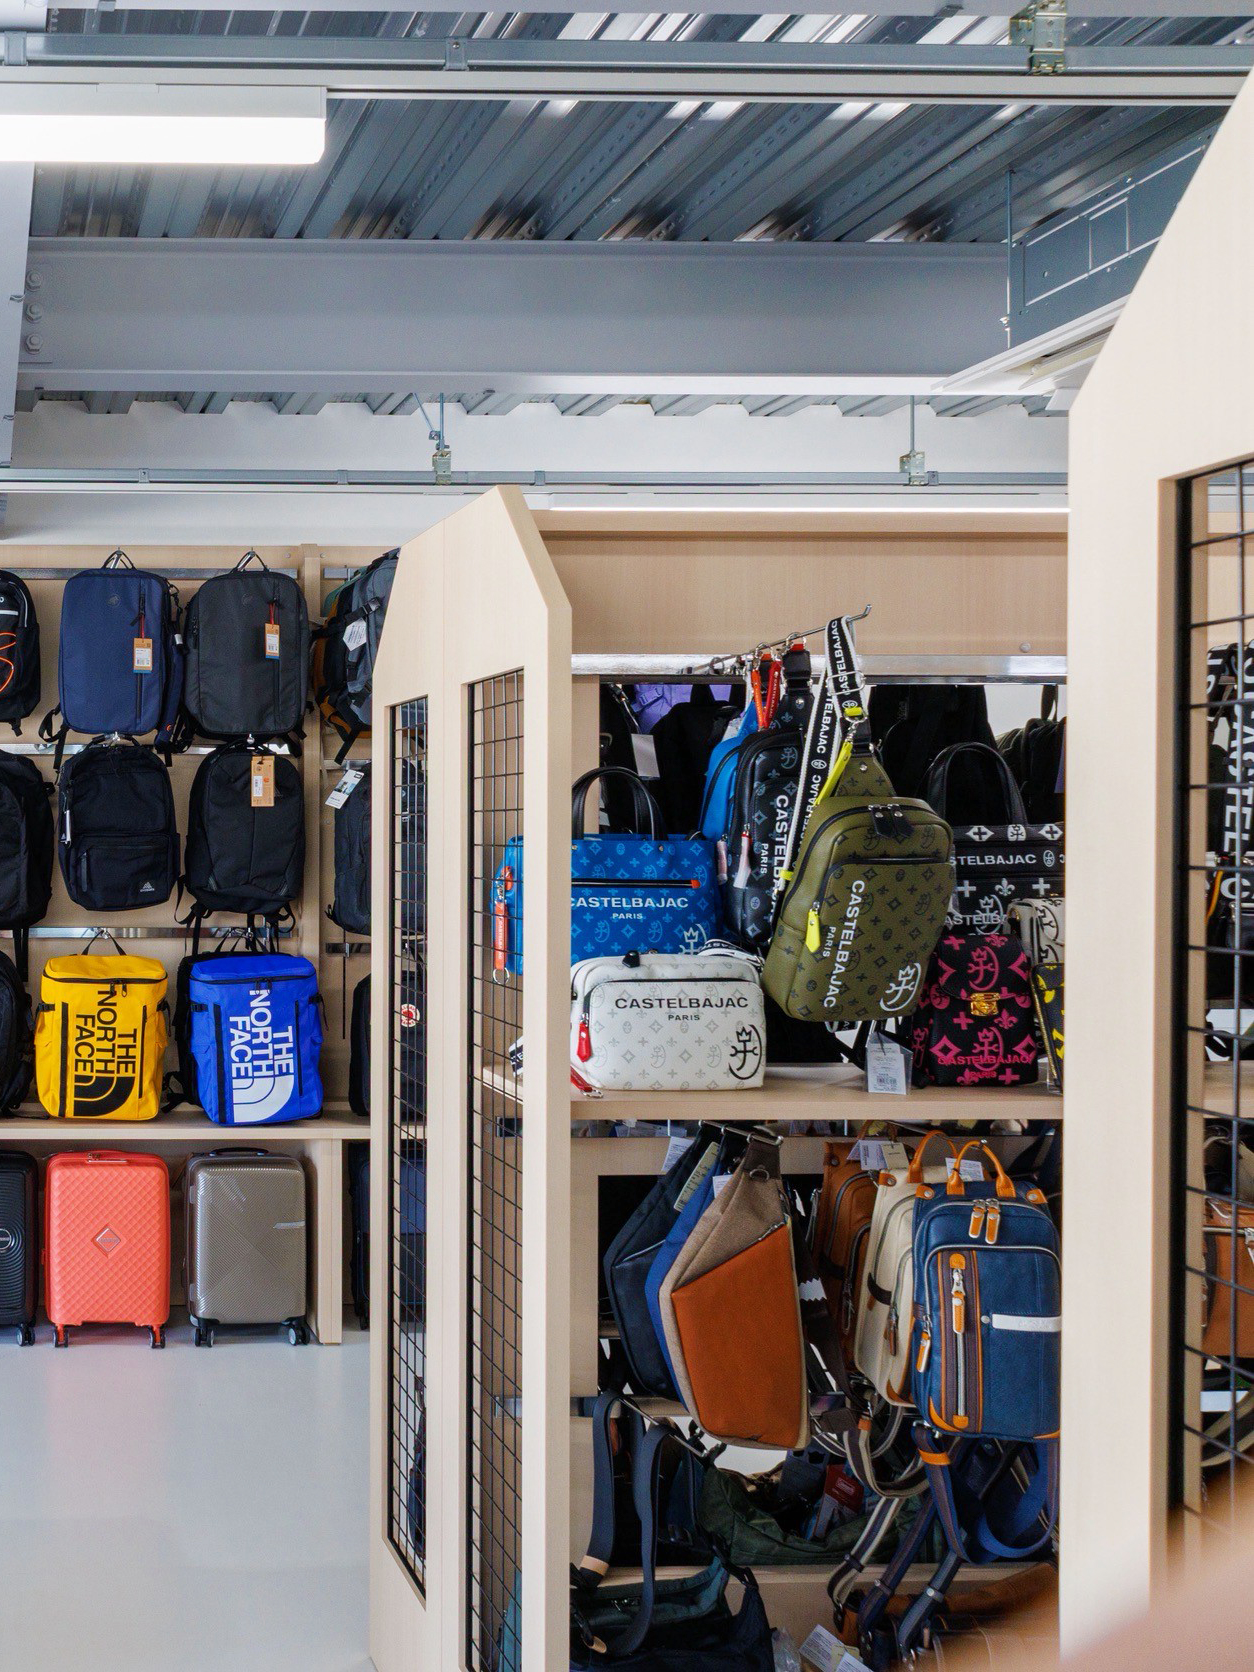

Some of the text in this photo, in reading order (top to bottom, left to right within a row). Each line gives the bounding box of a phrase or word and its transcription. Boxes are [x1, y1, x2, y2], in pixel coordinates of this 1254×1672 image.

[760, 843, 769, 874] PARIS
[949, 853, 1037, 866] STELBAJAC
[822, 926, 837, 958] PARIS
[824, 880, 865, 1008] CASTELBAJAC
[615, 997, 749, 1009] CASTELBAJAC
[74, 1014, 96, 1073] FACE
[95, 990, 117, 1075] NORTH
[116, 1028, 137, 1075] THE
[229, 1016, 253, 1078] FACE
[249, 989, 274, 1077] NORTH
[273, 1025, 295, 1075] THE
